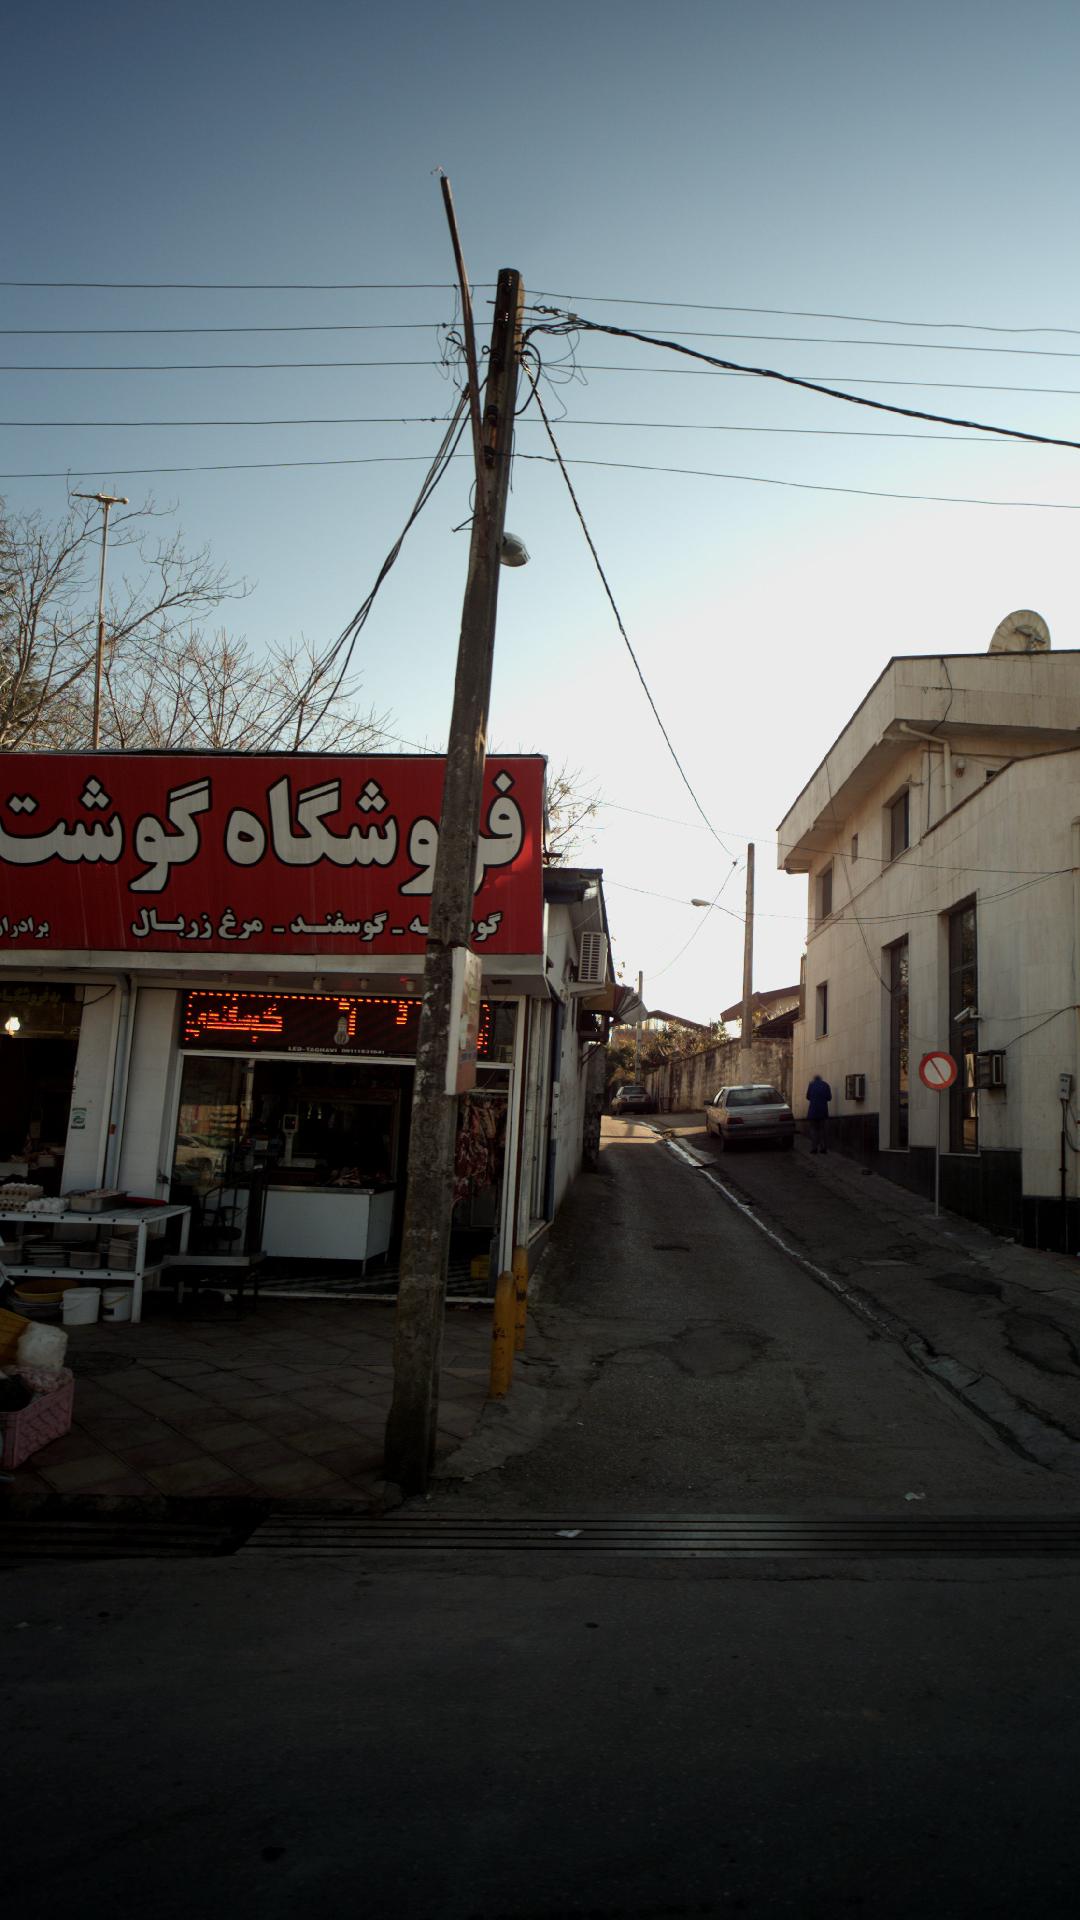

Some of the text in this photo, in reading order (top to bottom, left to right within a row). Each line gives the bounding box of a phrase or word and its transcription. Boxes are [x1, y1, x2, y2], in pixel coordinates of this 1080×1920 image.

[0, 776, 210, 891] گوشت
[218, 908, 263, 939] مرغ
[290, 912, 387, 941] گوسفند
